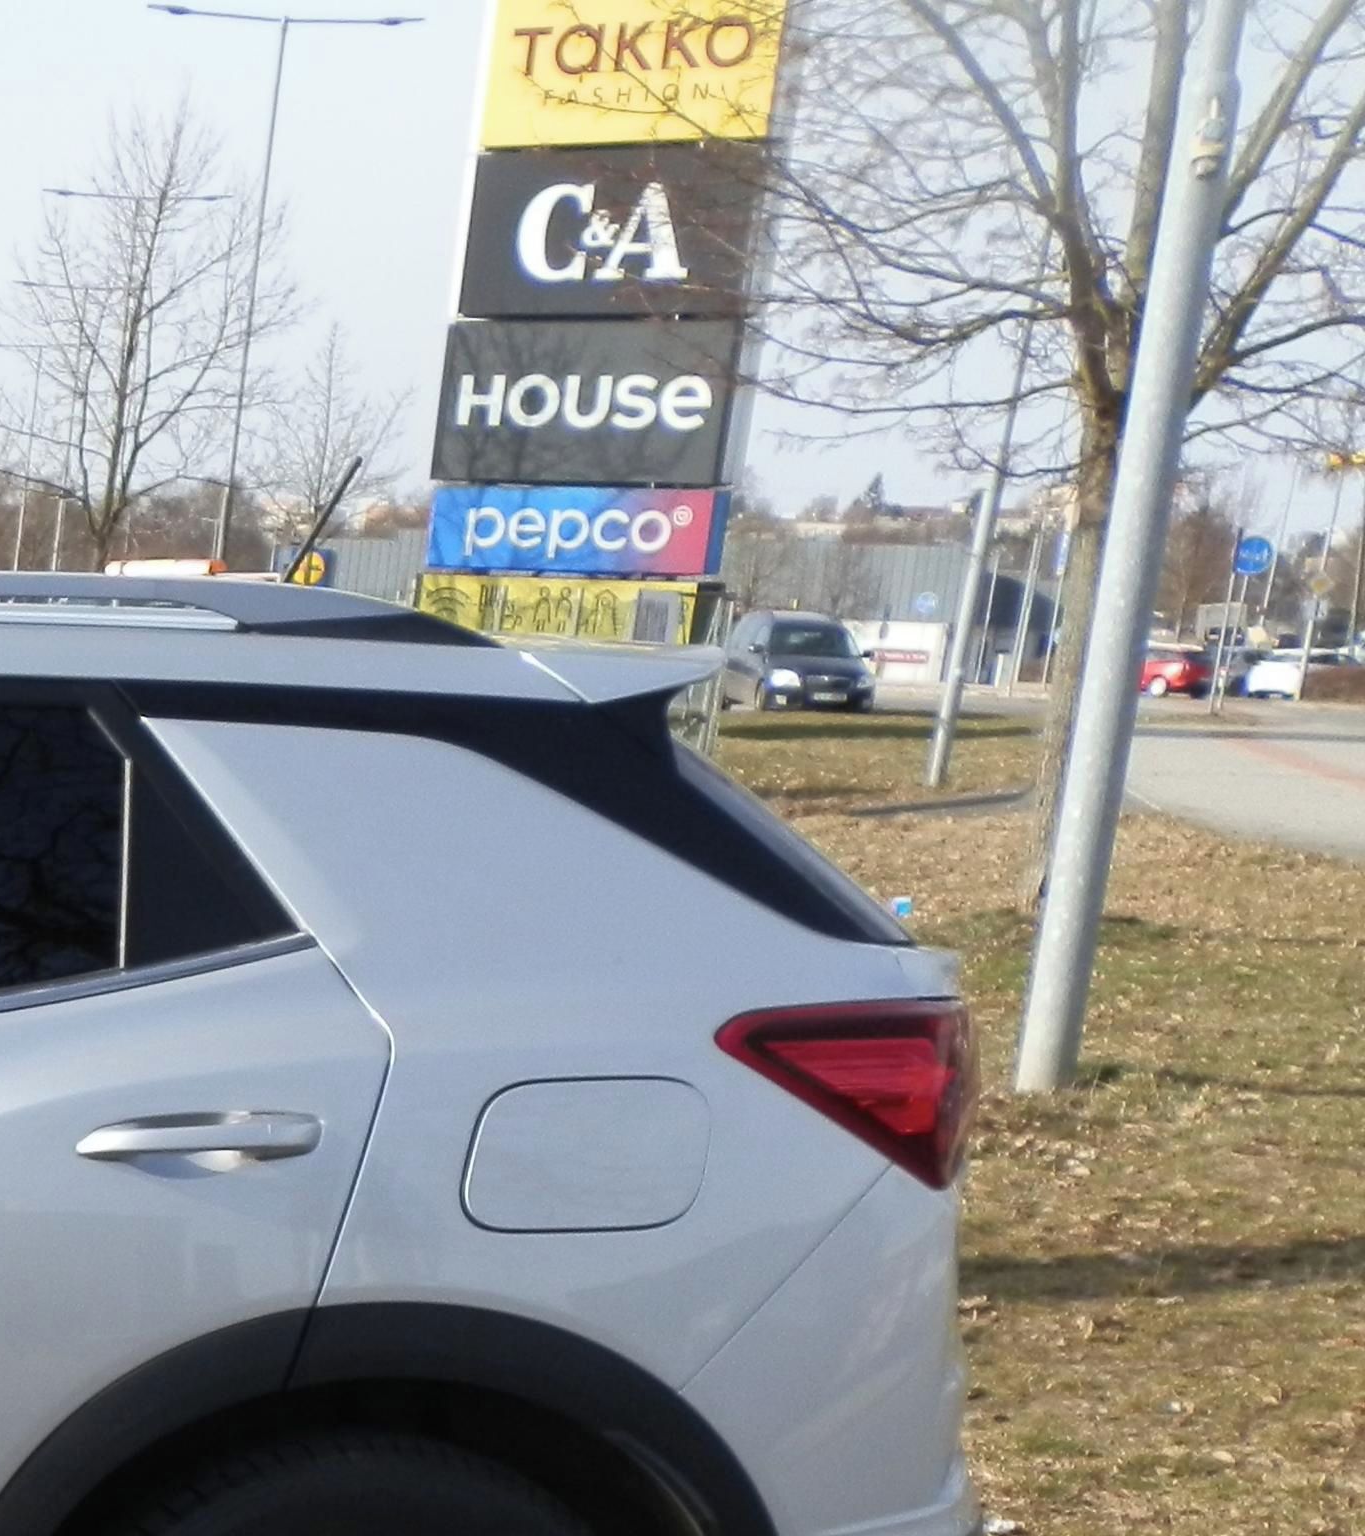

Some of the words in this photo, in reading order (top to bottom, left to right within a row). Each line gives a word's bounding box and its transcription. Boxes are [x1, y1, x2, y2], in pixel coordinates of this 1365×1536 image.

[543, 83, 710, 105] FASHION
[516, 181, 689, 282] C&A
[464, 505, 673, 558] pepco
